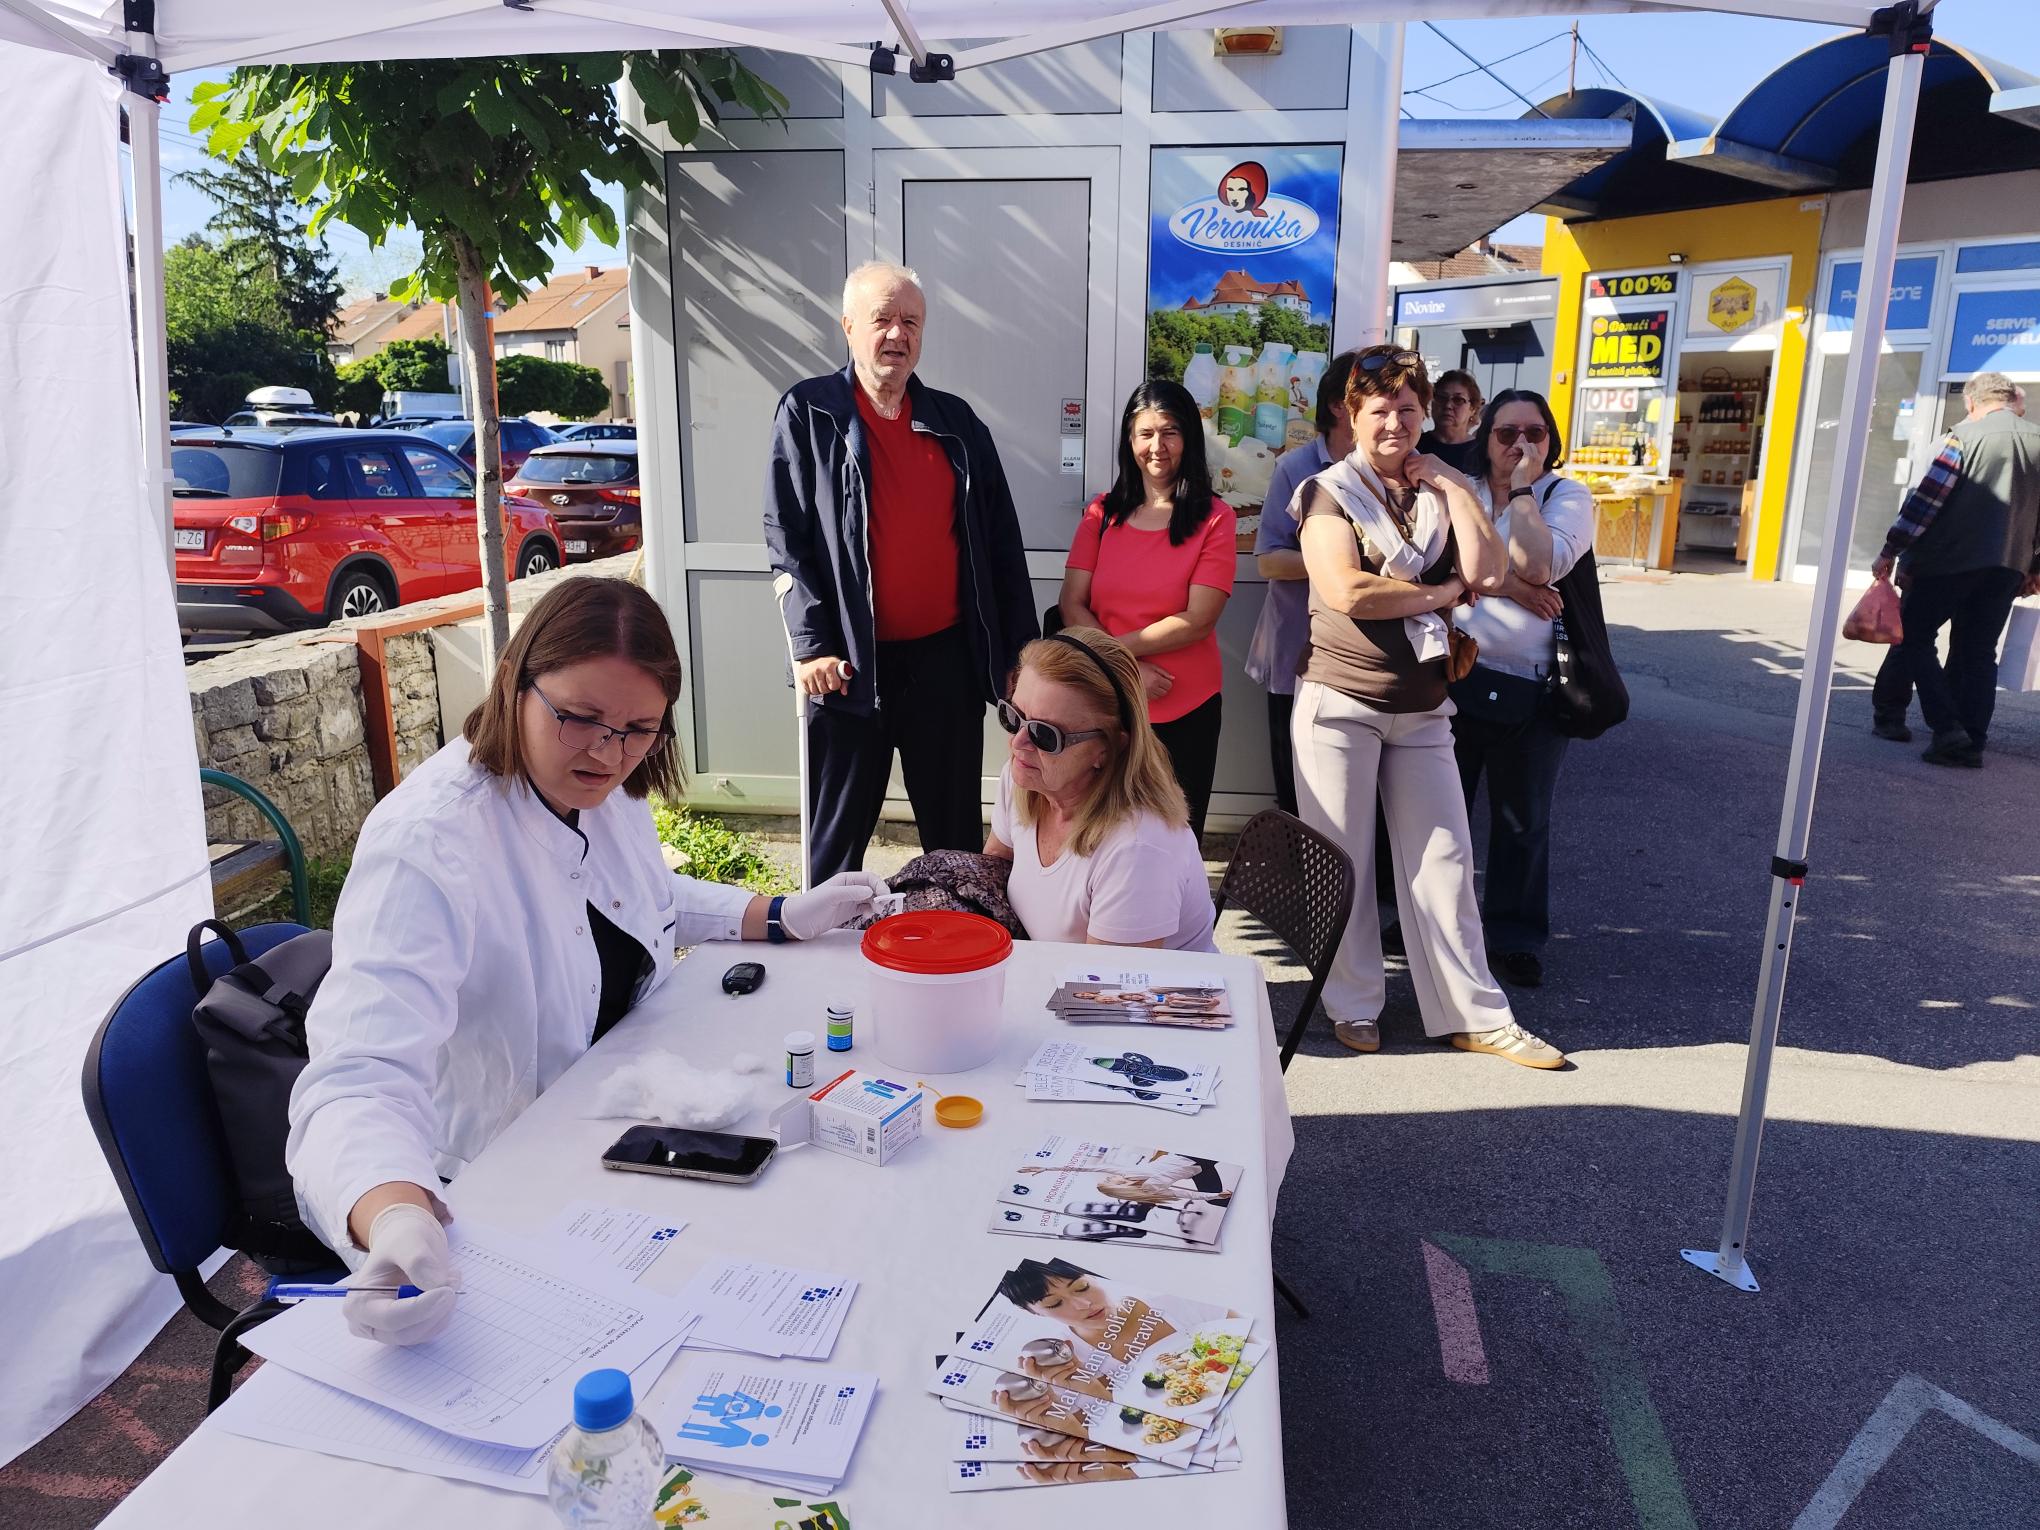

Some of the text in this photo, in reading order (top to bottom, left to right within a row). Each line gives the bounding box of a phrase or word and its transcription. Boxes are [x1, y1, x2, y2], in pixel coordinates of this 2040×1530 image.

[1181, 207, 1304, 239] Veronika
[1607, 275, 1672, 296] 100%
[1986, 317, 2037, 330] SERVIS
[1590, 334, 1662, 364] MED
[1588, 388, 1635, 410] OPG
[1070, 1297, 1137, 1385] Manje soli za
[1106, 1308, 1164, 1391] više zdravlja
